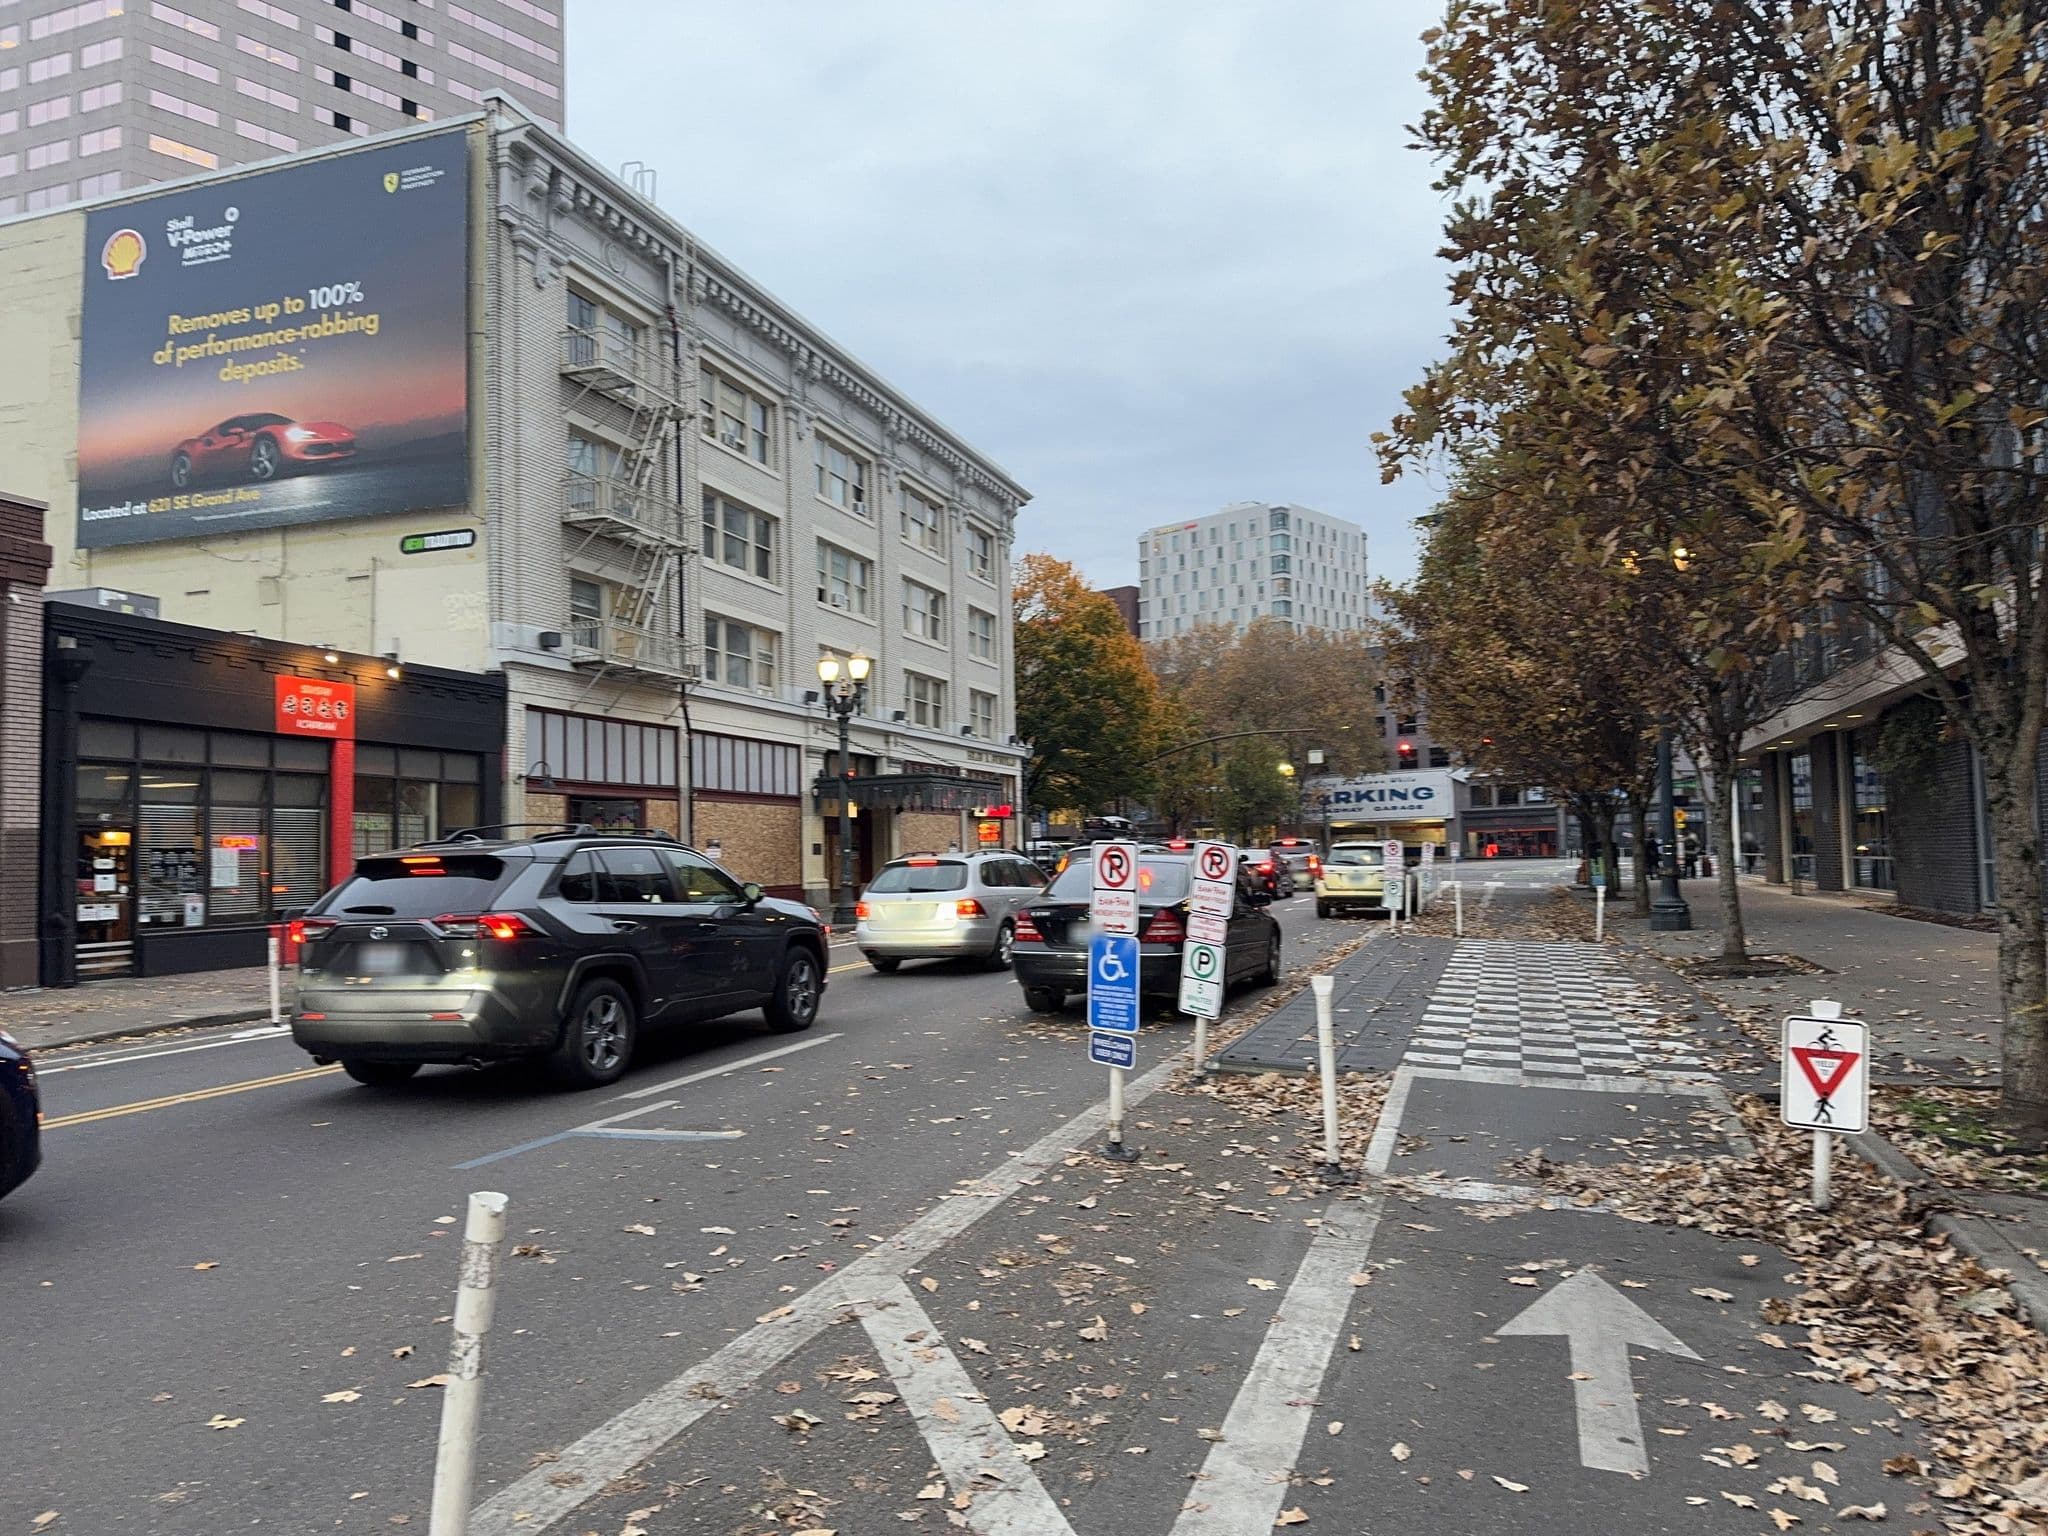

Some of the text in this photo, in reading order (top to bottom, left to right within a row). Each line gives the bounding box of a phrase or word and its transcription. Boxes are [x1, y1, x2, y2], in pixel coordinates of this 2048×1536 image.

[166, 215, 194, 232] Shell
[166, 225, 234, 247] V-Power
[168, 280, 364, 335] Removes up to 100%
[153, 311, 380, 368] of performance-robbing
[82, 501, 131, 521] Located
[132, 502, 147, 515] at
[173, 495, 189, 510] SE
[192, 488, 233, 507] Grand
